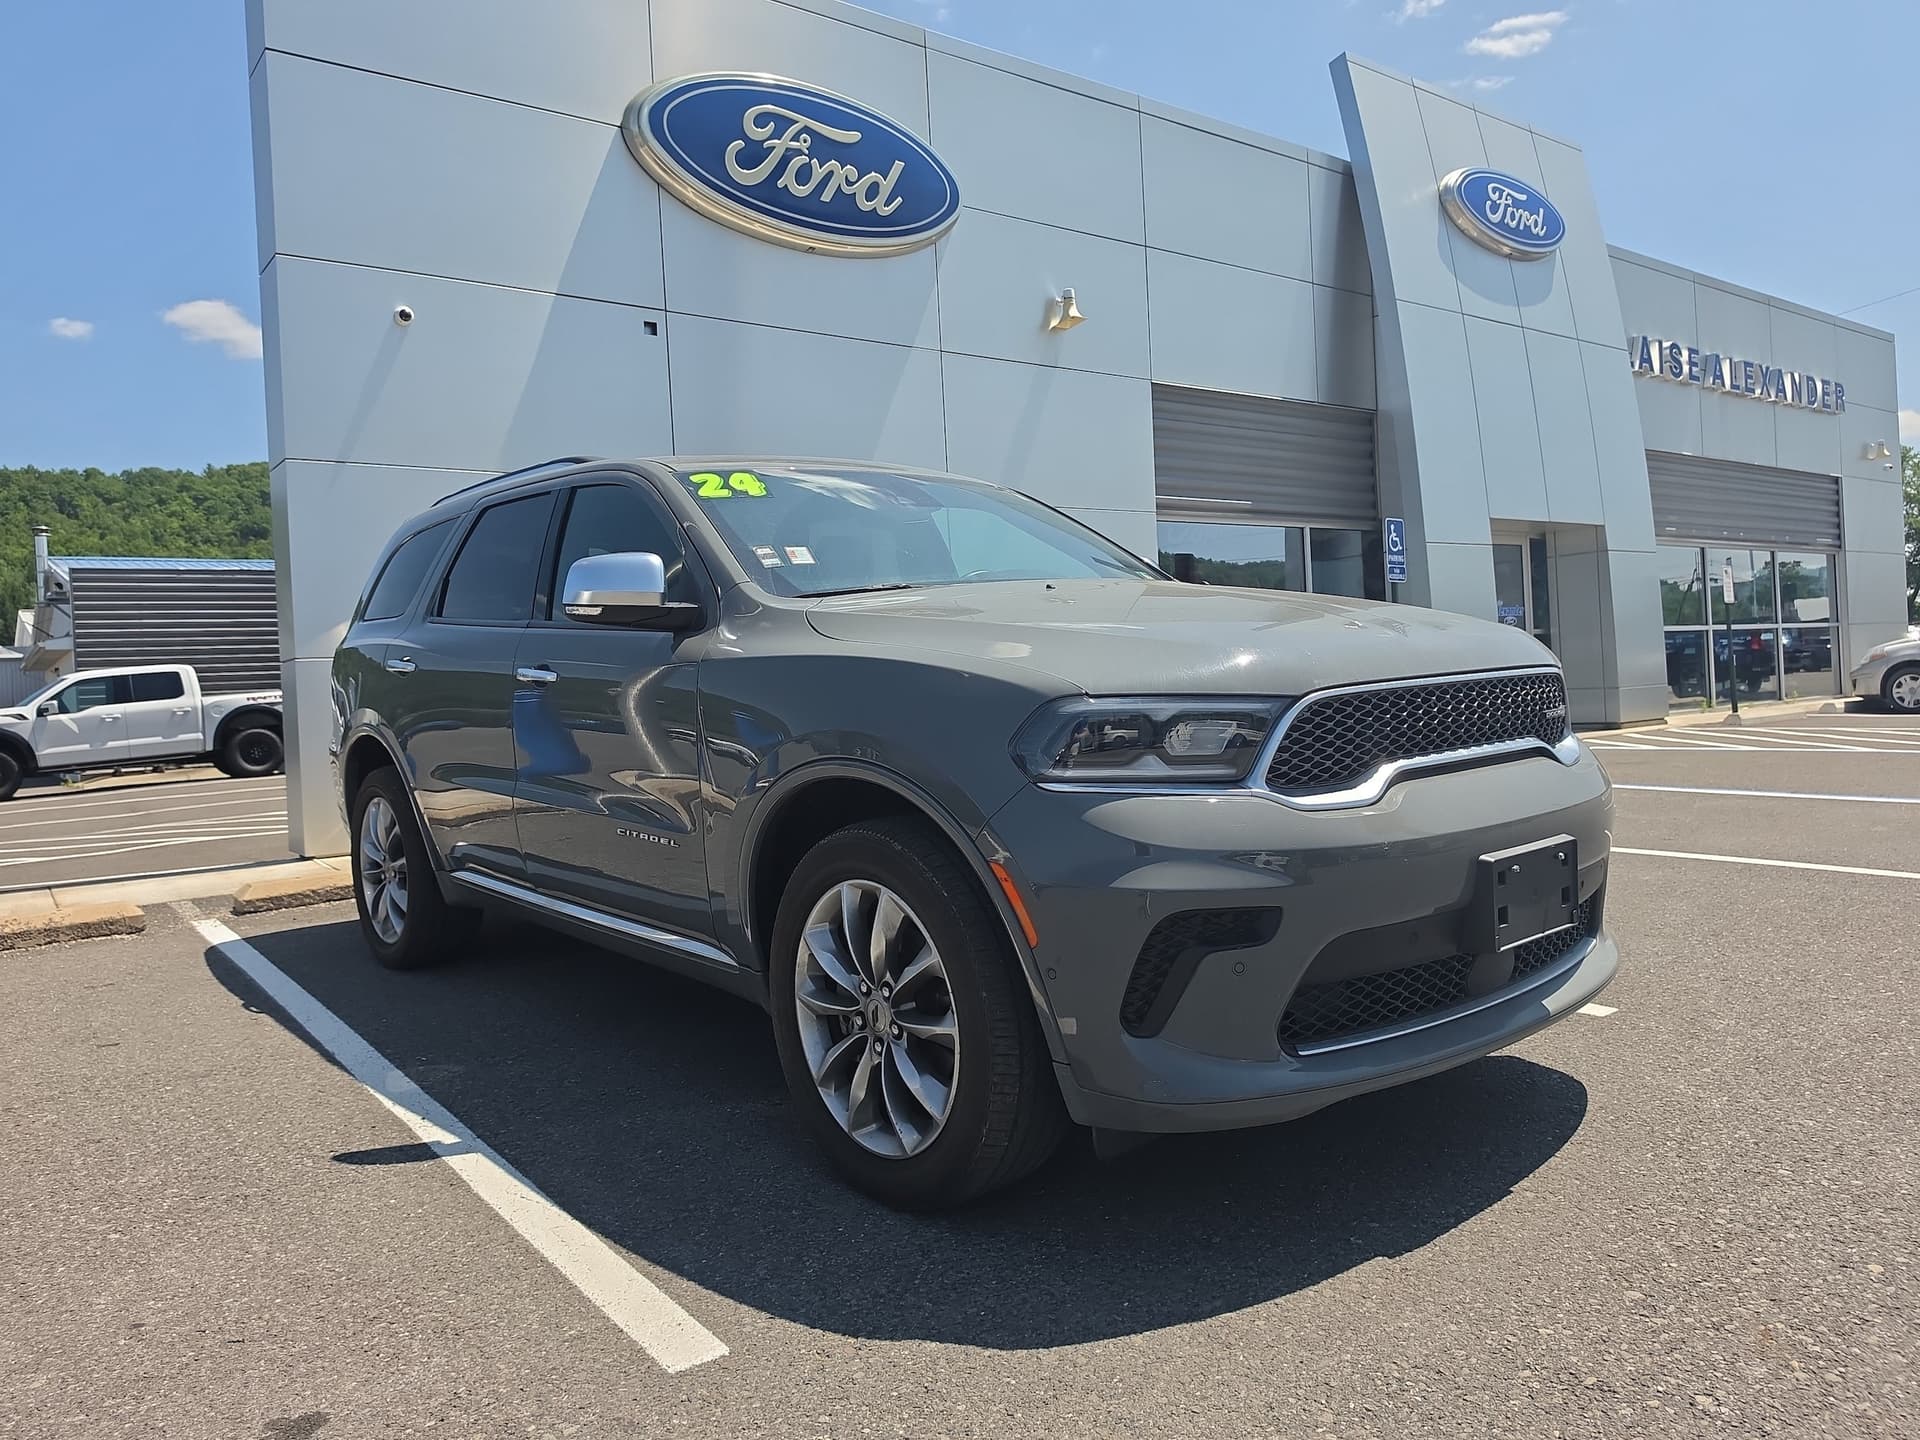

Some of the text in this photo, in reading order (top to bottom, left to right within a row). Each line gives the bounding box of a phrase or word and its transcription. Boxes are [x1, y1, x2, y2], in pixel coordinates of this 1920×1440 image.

[724, 104, 905, 216] Ford
[1485, 182, 1547, 237] Ford
[1630, 335, 1846, 412] AISE ALEXANDER
[688, 471, 768, 498] 24
[616, 827, 680, 848] CITADEL
